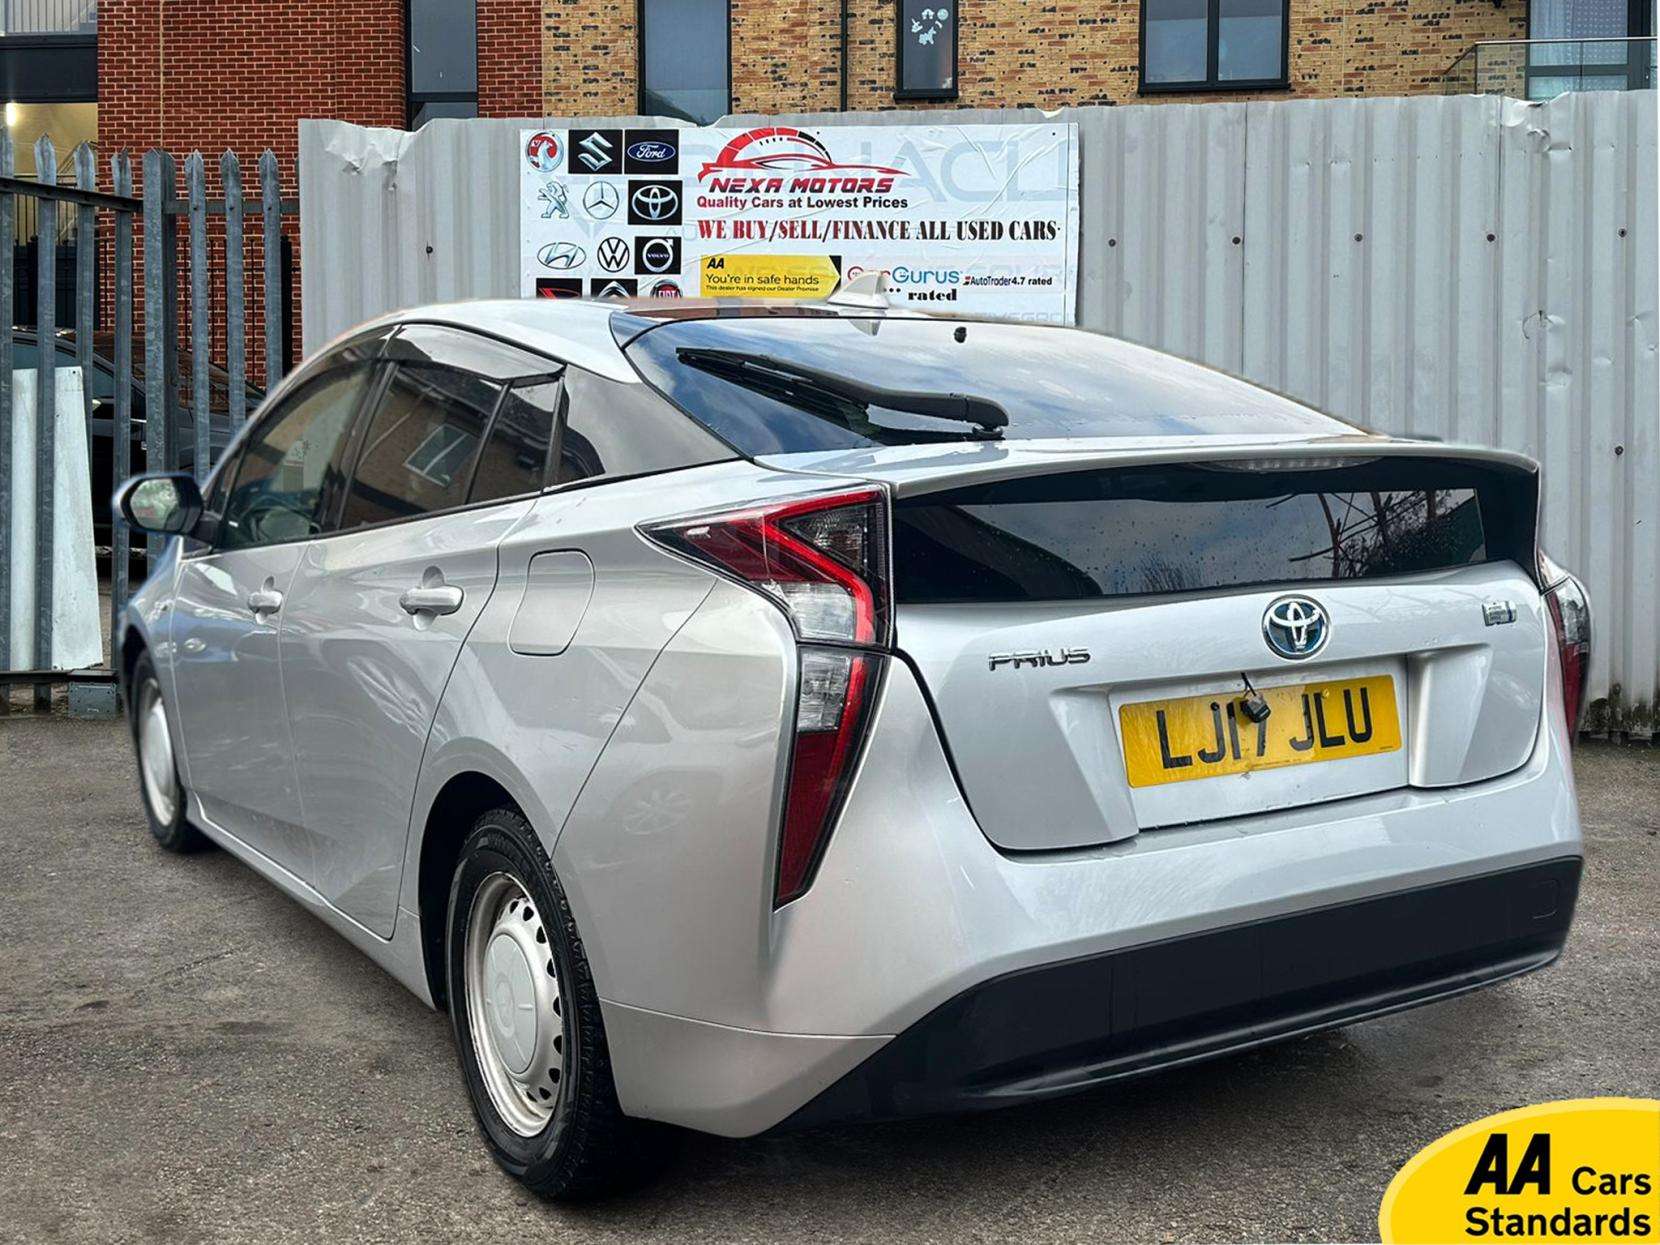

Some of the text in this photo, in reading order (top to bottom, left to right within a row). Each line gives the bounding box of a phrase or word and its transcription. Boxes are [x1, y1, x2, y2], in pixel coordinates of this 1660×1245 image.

[636, 143, 666, 159] Ford
[709, 177, 895, 193] NEXA MOTORS
[697, 195, 908, 211] Quality Cars at Lowest Prices
[697, 219, 727, 240] WE
[916, 220, 950, 241] ALL
[957, 220, 1003, 241] USED
[706, 257, 725, 269] AA
[705, 273, 819, 285] You're in safe hands
[1027, 277, 1053, 286] rated
[908, 288, 958, 301] rated
[988, 647, 1091, 672] PRIUS
[1288, 687, 1373, 752] JLU
